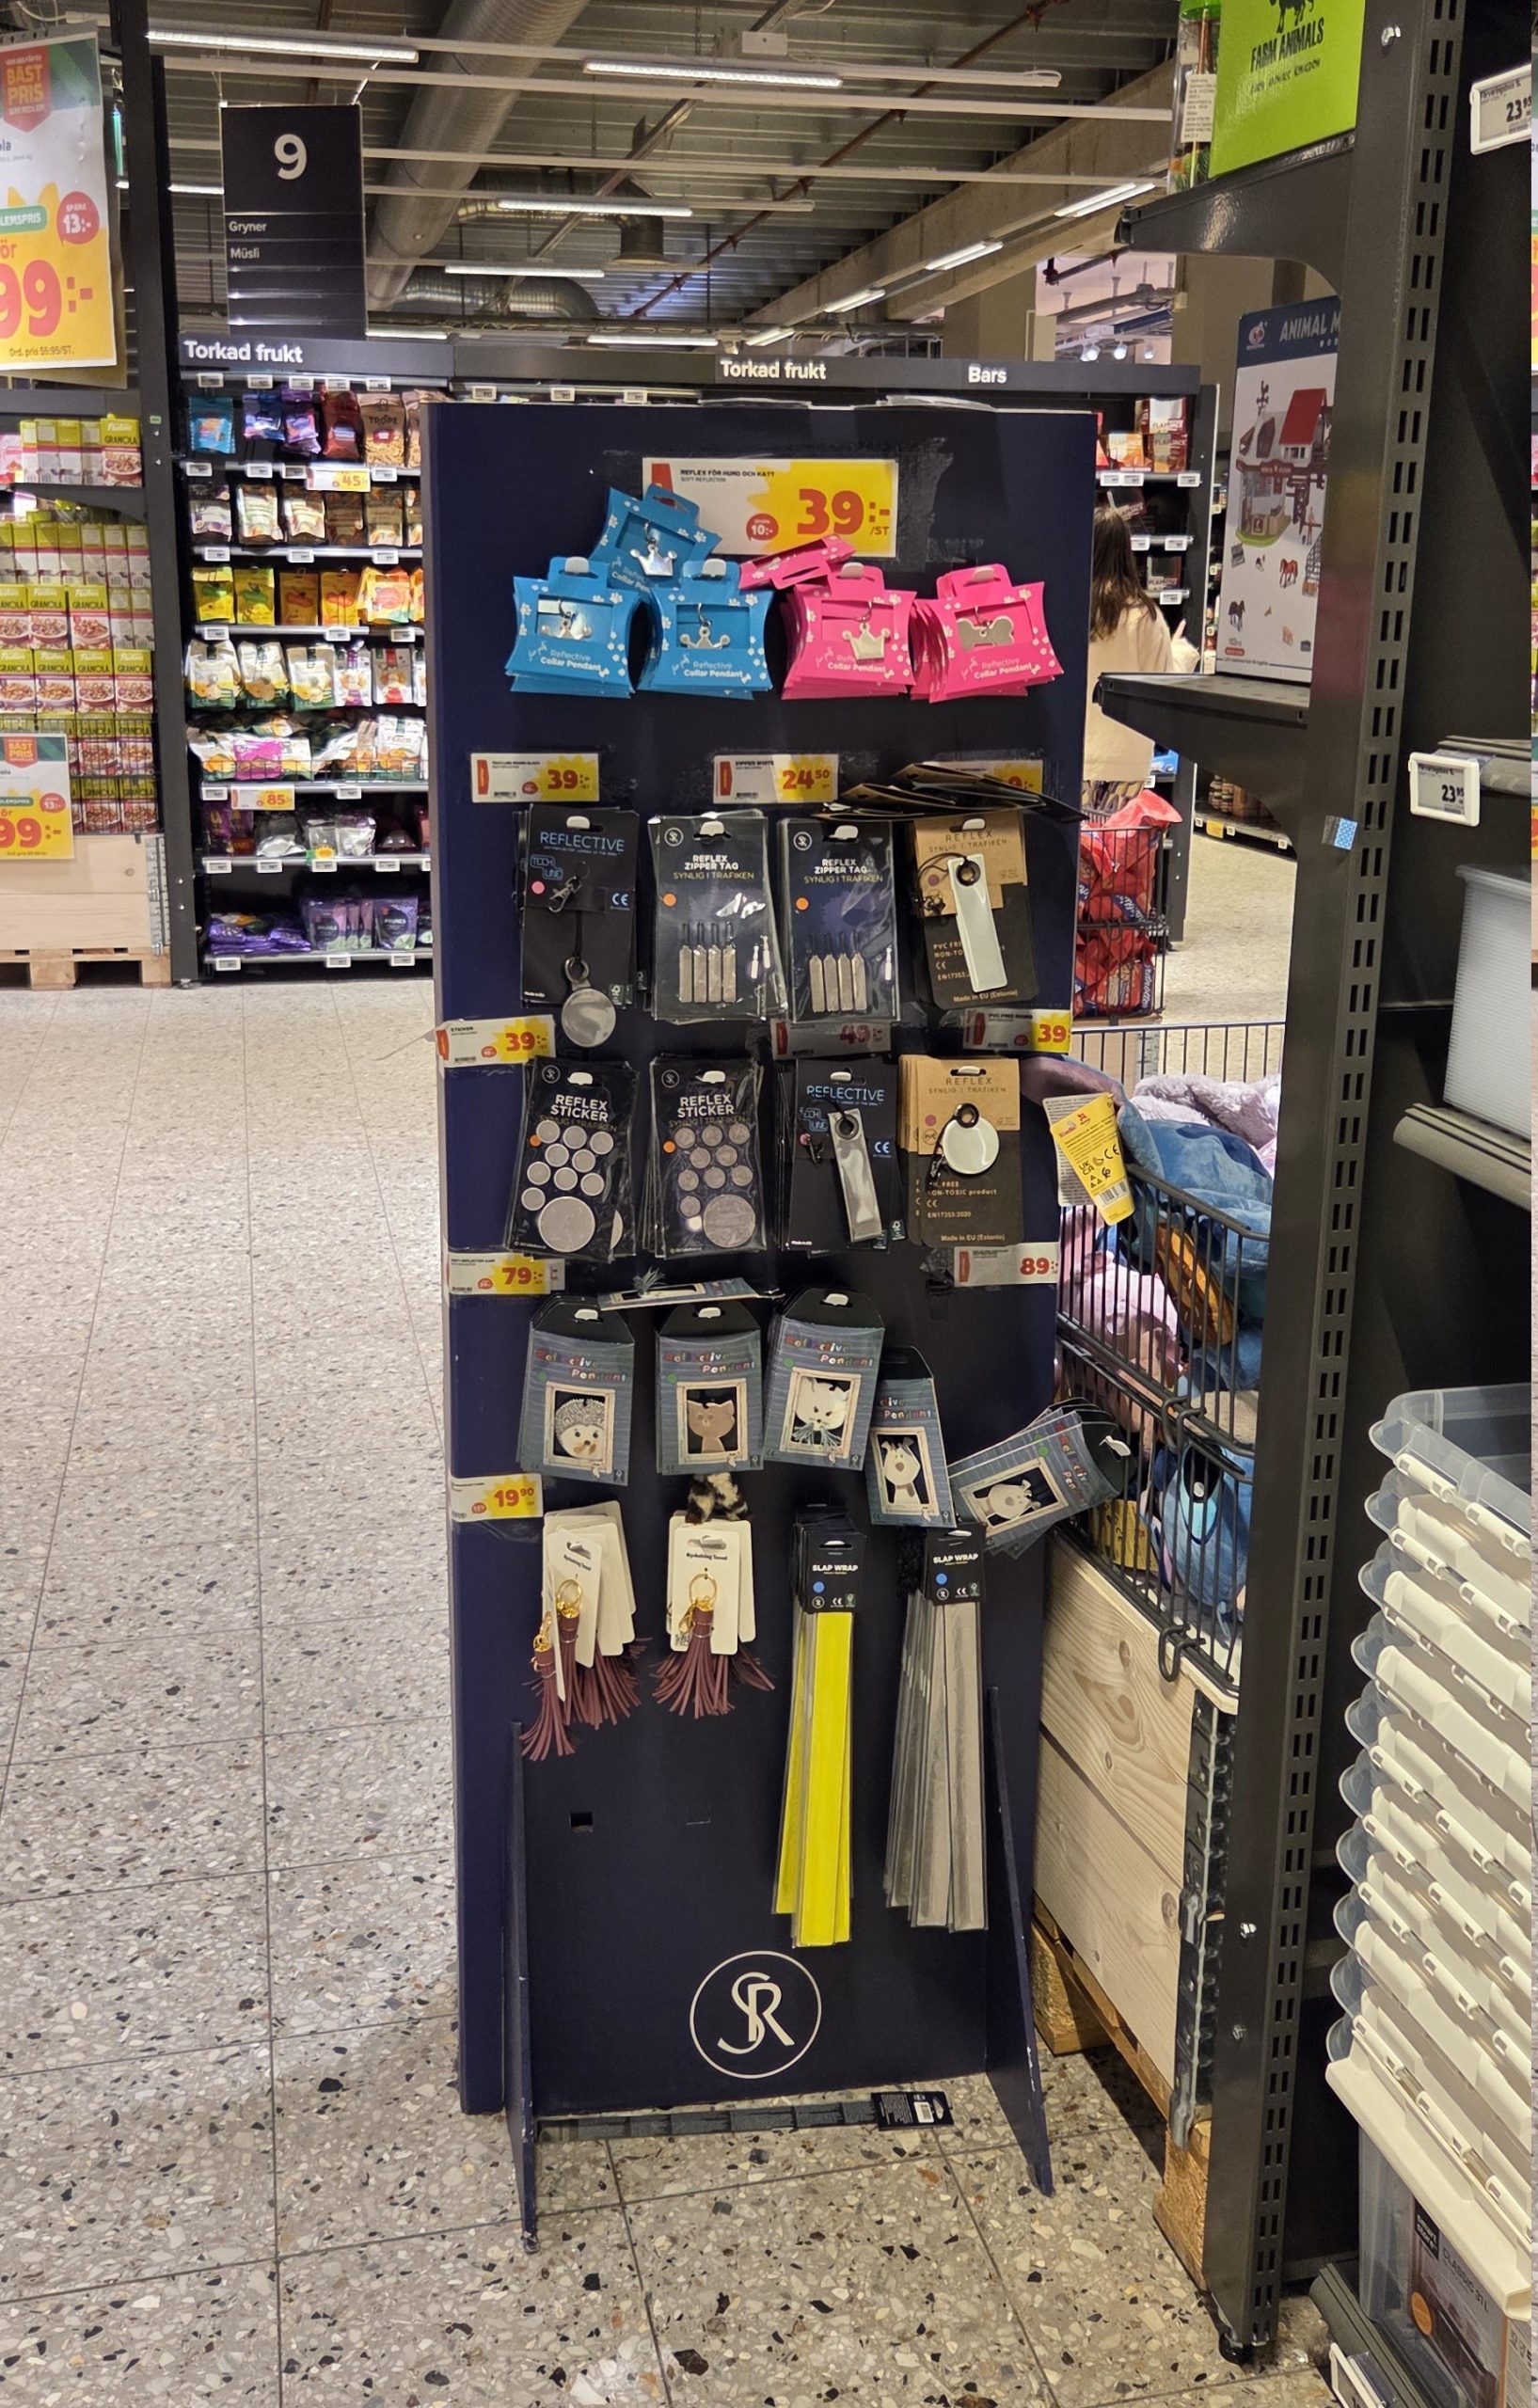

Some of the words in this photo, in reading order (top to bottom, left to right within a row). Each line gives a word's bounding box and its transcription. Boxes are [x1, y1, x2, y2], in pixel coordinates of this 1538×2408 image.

[1250, 38, 1277, 72] FARM
[1279, 17, 1324, 60] ANIMALS
[8, 84, 44, 105] PRIS
[1507, 100, 1522, 122] 23
[274, 134, 308, 180] 9
[63, 214, 92, 234] 13:-
[229, 221, 267, 234] Gryner
[230, 247, 260, 259] Müsli
[1279, 313, 1326, 341] ANIMAL
[24, 347, 39, 358] pris
[183, 340, 250, 361] Torkad
[255, 343, 304, 363] frukt
[721, 359, 780, 379] Torkad
[785, 359, 827, 380] frukt
[968, 365, 1007, 384] Bars
[104, 436, 137, 445] GRANOLA
[797, 488, 891, 535] 39:-
[870, 526, 890, 536] /ST
[31, 599, 64, 609] GRANOLA
[72, 600, 104, 610] GRANOLA
[550, 649, 591, 662] Reflective
[38, 664, 71, 673] GRANOLA
[77, 664, 110, 673] GRANOLA
[118, 664, 149, 673] GRANOLA
[540, 657, 565, 667] Collar
[566, 658, 602, 671] Pendant
[693, 660, 732, 670] Reflective
[828, 661, 851, 672] Collar
[852, 663, 886, 674] Pendant
[981, 657, 1020, 669] Reflective
[684, 669, 708, 678] Collar
[709, 669, 743, 679] Pendant
[975, 667, 998, 679] Collar
[999, 662, 1033, 675] Pendant
[1442, 784, 1455, 803] 23
[540, 832, 625, 852] REFLECTIVE
[945, 830, 992, 843] REFLEX
[928, 843, 956, 854] SYNLIG
[967, 839, 1007, 848] TRAFIKEN
[692, 854, 728, 863] REFLEX
[822, 858, 857, 866] REFLEX
[685, 863, 718, 871] ZIPPER
[720, 863, 739, 871] TAG
[815, 865, 848, 874] ZIPPER
[849, 865, 867, 874] TAG
[674, 872, 705, 880] SYNLIG
[711, 872, 754, 880] TRAFIKEN
[803, 875, 835, 884] SYNLIG
[842, 875, 883, 883] TRAFIKEN
[612, 893, 628, 906] CE
[979, 992, 990, 1001] EU
[945, 1077, 992, 1085] REFLEX
[555, 1094, 608, 1111] REFLEX
[680, 1094, 732, 1107] REFLEX
[550, 1104, 609, 1122] STICKER
[677, 1104, 734, 1118] STICKER
[875, 1141, 890, 1154] CE
[1104, 1145, 1120, 1160] CE
[969, 1188, 997, 1198] product
[933, 1555, 954, 1563] SLAP
[955, 1553, 979, 1561] WRAP
